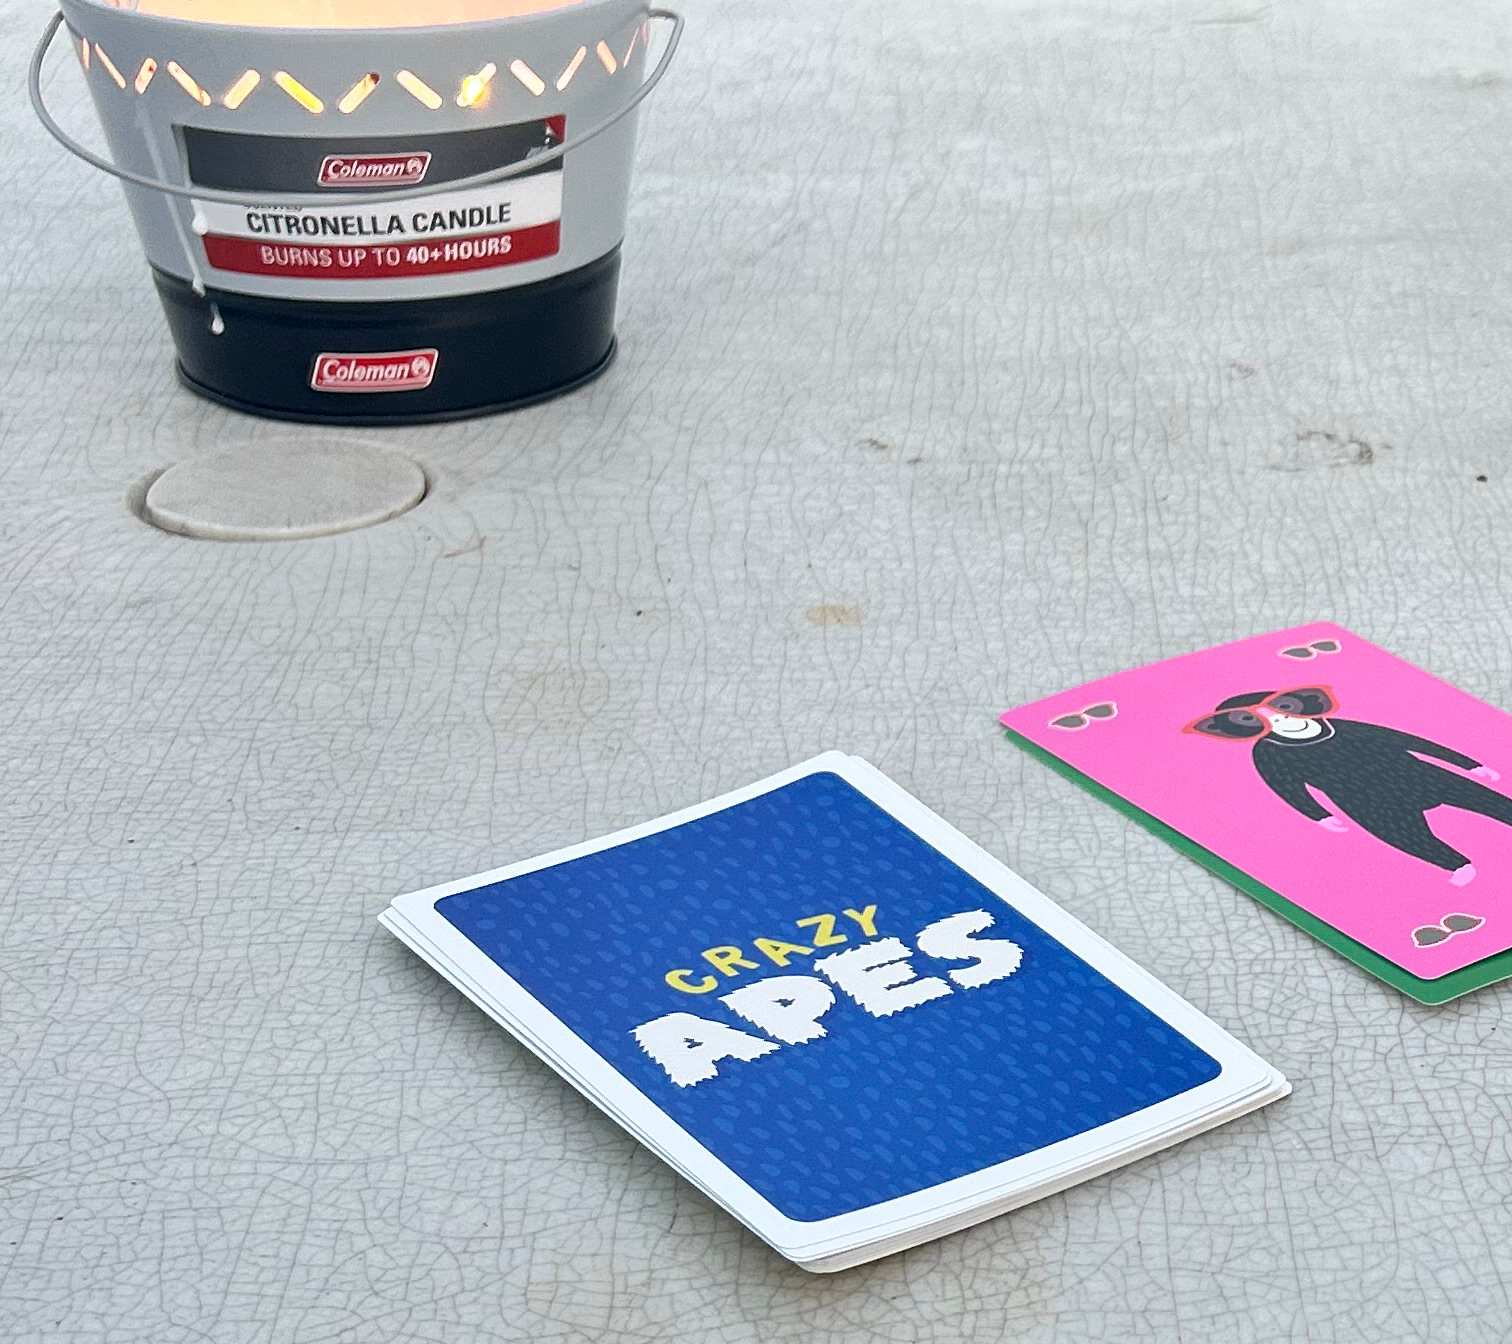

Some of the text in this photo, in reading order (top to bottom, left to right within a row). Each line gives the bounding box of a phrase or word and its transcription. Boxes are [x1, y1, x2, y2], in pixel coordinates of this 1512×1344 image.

[327, 160, 405, 179] Coleman
[246, 202, 512, 235] CITRONELLA CANDLE
[260, 245, 333, 267] BURNS
[337, 247, 367, 267] UP
[372, 246, 400, 267] TO
[322, 358, 410, 383] Coleman
[664, 904, 879, 995] CRAZY
[628, 908, 1025, 1089] APES
